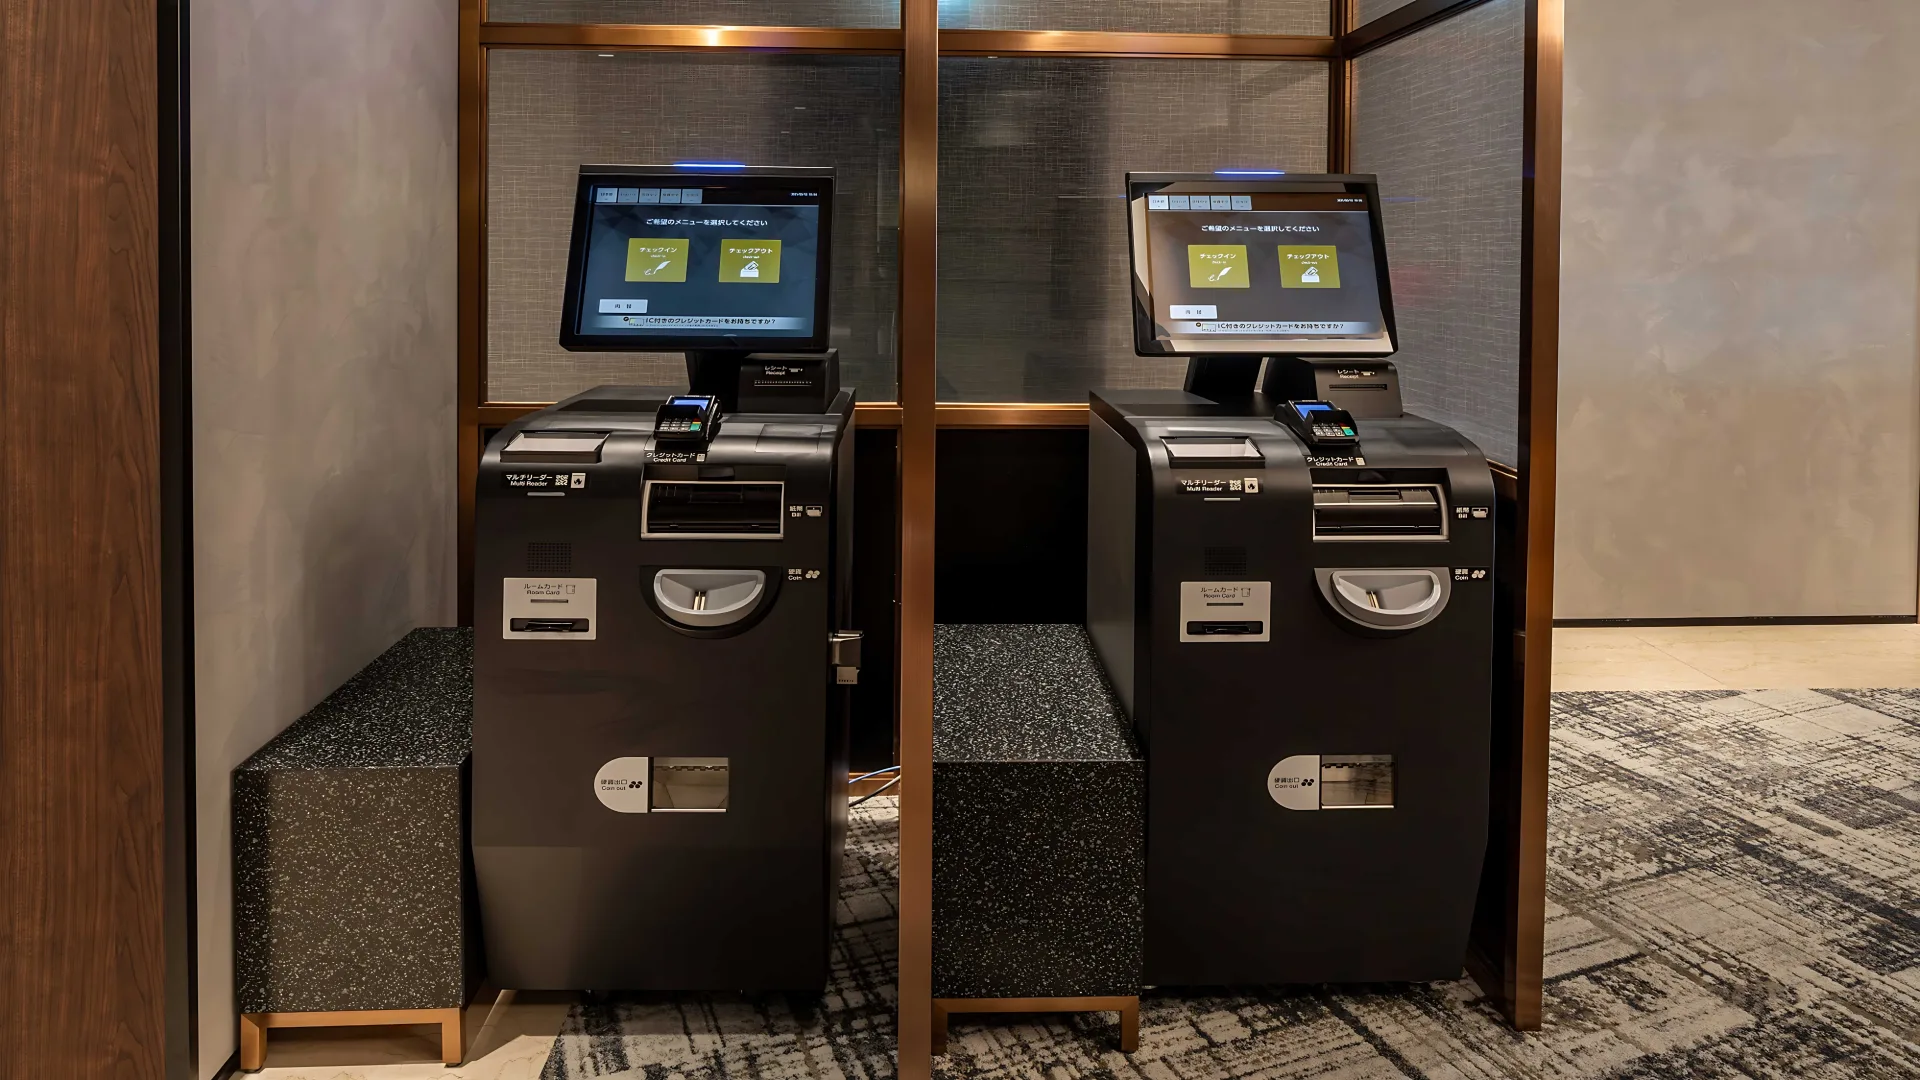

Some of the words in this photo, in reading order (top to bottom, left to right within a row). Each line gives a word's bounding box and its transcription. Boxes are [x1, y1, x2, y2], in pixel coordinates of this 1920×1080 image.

[646, 218, 768, 227] ご希望のメニューを選択してください
